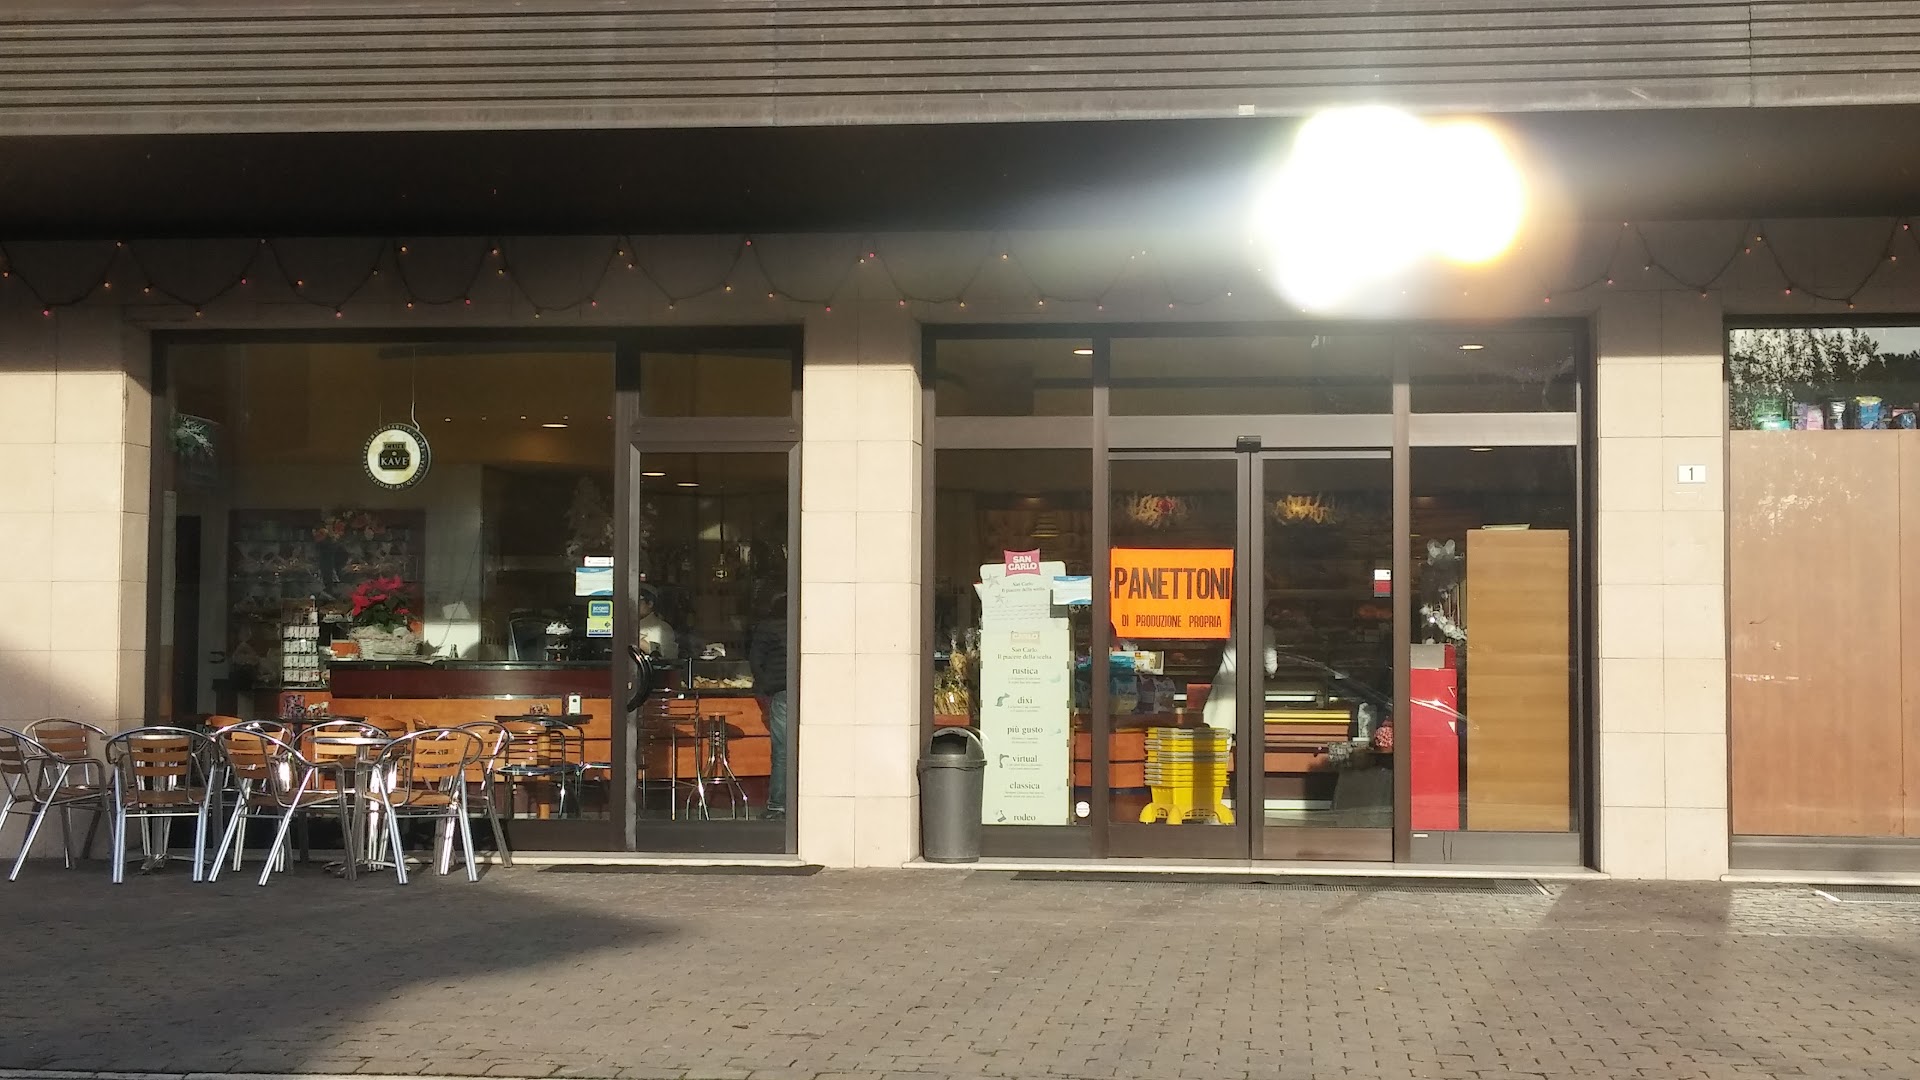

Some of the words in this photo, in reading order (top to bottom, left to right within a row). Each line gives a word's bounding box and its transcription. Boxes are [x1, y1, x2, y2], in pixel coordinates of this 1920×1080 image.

[1688, 466, 1694, 481] 1
[1013, 555, 1032, 563] SAN
[1008, 562, 1037, 571] CARLO
[1114, 567, 1231, 600] PANETTONI
[1121, 614, 1129, 627] DI
[1136, 614, 1182, 628] PRODUZIONE
[1188, 615, 1222, 628] PROPRIA
[1012, 667, 1039, 675] rustica
[1017, 696, 1033, 704] dixi
[1007, 726, 1020, 735] più
[1021, 727, 1044, 735] gusto
[1012, 755, 1038, 763] virtual
[1009, 782, 1040, 790] classica
[1013, 813, 1036, 821] rodeo
